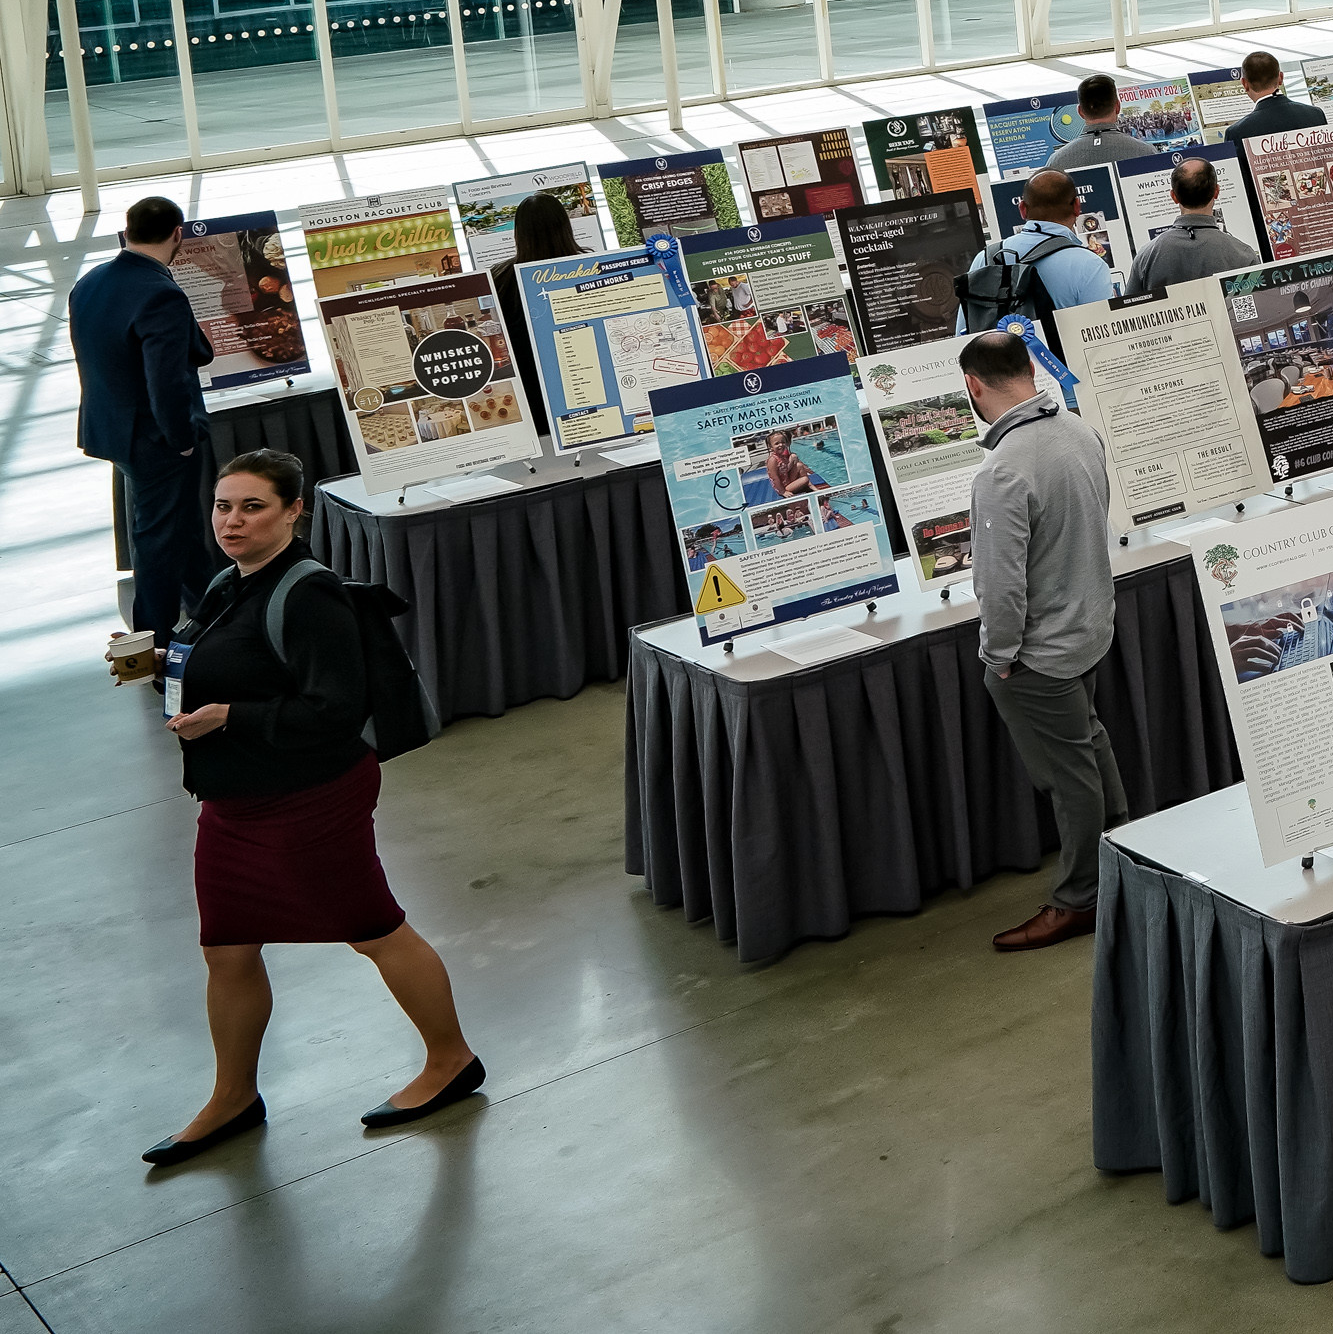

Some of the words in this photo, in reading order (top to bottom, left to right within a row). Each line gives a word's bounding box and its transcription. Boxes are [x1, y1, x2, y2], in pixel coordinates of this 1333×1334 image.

[990, 121, 1018, 129] RACQUET
[1019, 116, 1052, 125] STRINGING
[992, 126, 1031, 136] RESERVATION
[994, 134, 1025, 144] CALENDAR
[642, 182, 665, 191] CRISP
[667, 178, 693, 187] EDGES
[309, 214, 360, 226] HOUSTON
[365, 206, 411, 217] RACQUET
[417, 201, 442, 210] CLUB
[849, 222, 883, 232] WANAKAH
[885, 216, 918, 226] COUNTRY
[920, 213, 938, 221] CLUB
[313, 236, 368, 260] Just
[380, 224, 451, 249] Chillin
[850, 227, 904, 243] barrel-aged
[854, 241, 893, 255] cocktails
[602, 261, 629, 270] PASSPORT
[712, 265, 734, 275] FIND
[736, 262, 753, 271] THE
[755, 256, 785, 268] GOOD
[787, 251, 811, 262] STUFF
[533, 262, 600, 283] Wanakah
[580, 282, 596, 291] HOW
[604, 275, 628, 286] WORKS
[1081, 324, 1110, 342] CRISIS
[1112, 308, 1184, 335] COMMUNICATIONS
[1186, 303, 1207, 318] PLAN
[1129, 336, 1172, 350] INTRODUCTION
[421, 345, 479, 362] WHISKEY
[425, 358, 482, 374] TASTING
[433, 370, 481, 386] POP-UP
[1140, 387, 1152, 395] THE
[1154, 379, 1184, 392] RESPONSE
[698, 415, 734, 430] SAFETY
[739, 408, 767, 421] MATS
[770, 403, 791, 414] FOR
[794, 396, 822, 409] SWIM
[733, 414, 793, 434] PROGRAMS
[1295, 458, 1306, 469] #6
[1307, 454, 1321, 465] CLUB
[1244, 537, 1296, 560] COUNTRY
[1299, 529, 1327, 544] CLUB
